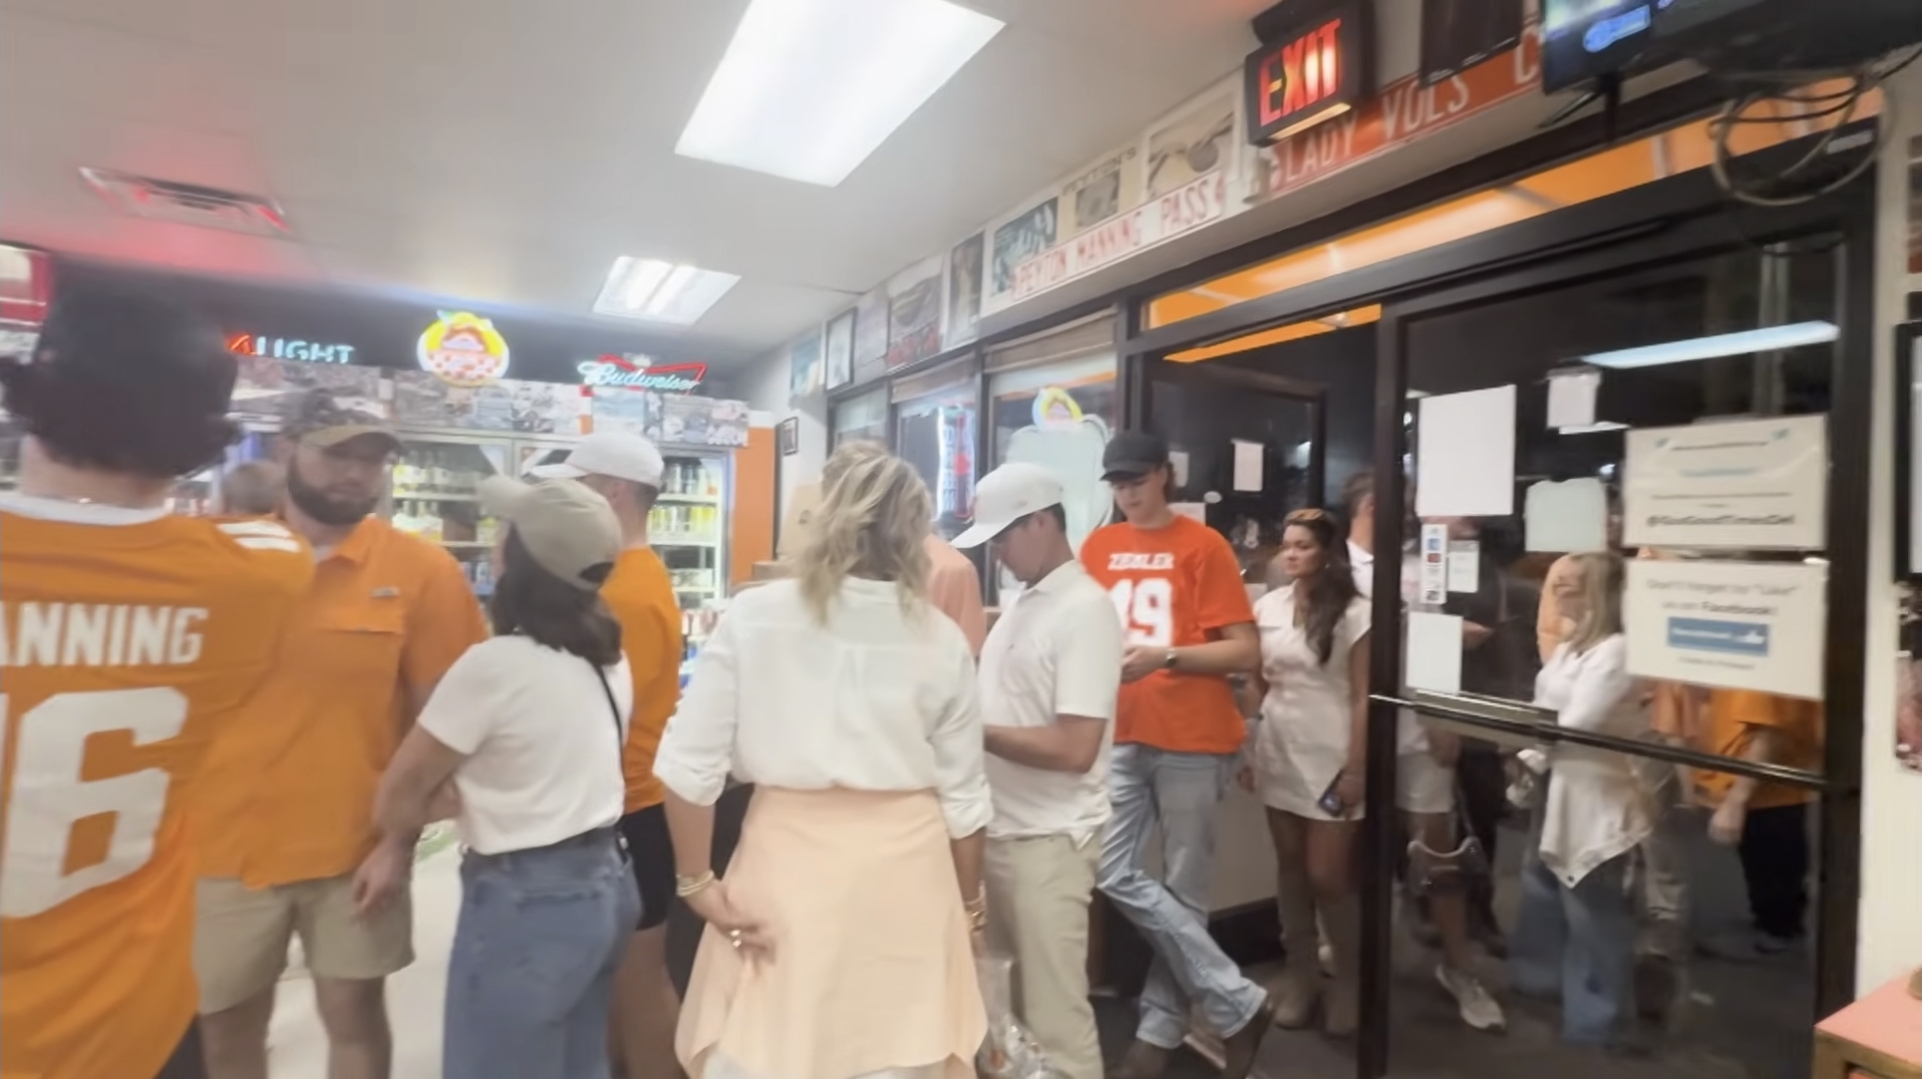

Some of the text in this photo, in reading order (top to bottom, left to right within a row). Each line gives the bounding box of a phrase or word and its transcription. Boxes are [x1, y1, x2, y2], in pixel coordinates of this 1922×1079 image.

[1259, 18, 1342, 127] EXIT
[1286, 112, 1357, 183] LADY
[1382, 74, 1470, 139] VOLS
[1161, 179, 1208, 235] PASS
[0, 601, 209, 667] NNING
[1111, 578, 1172, 647] 19
[0, 685, 189, 919] 6
